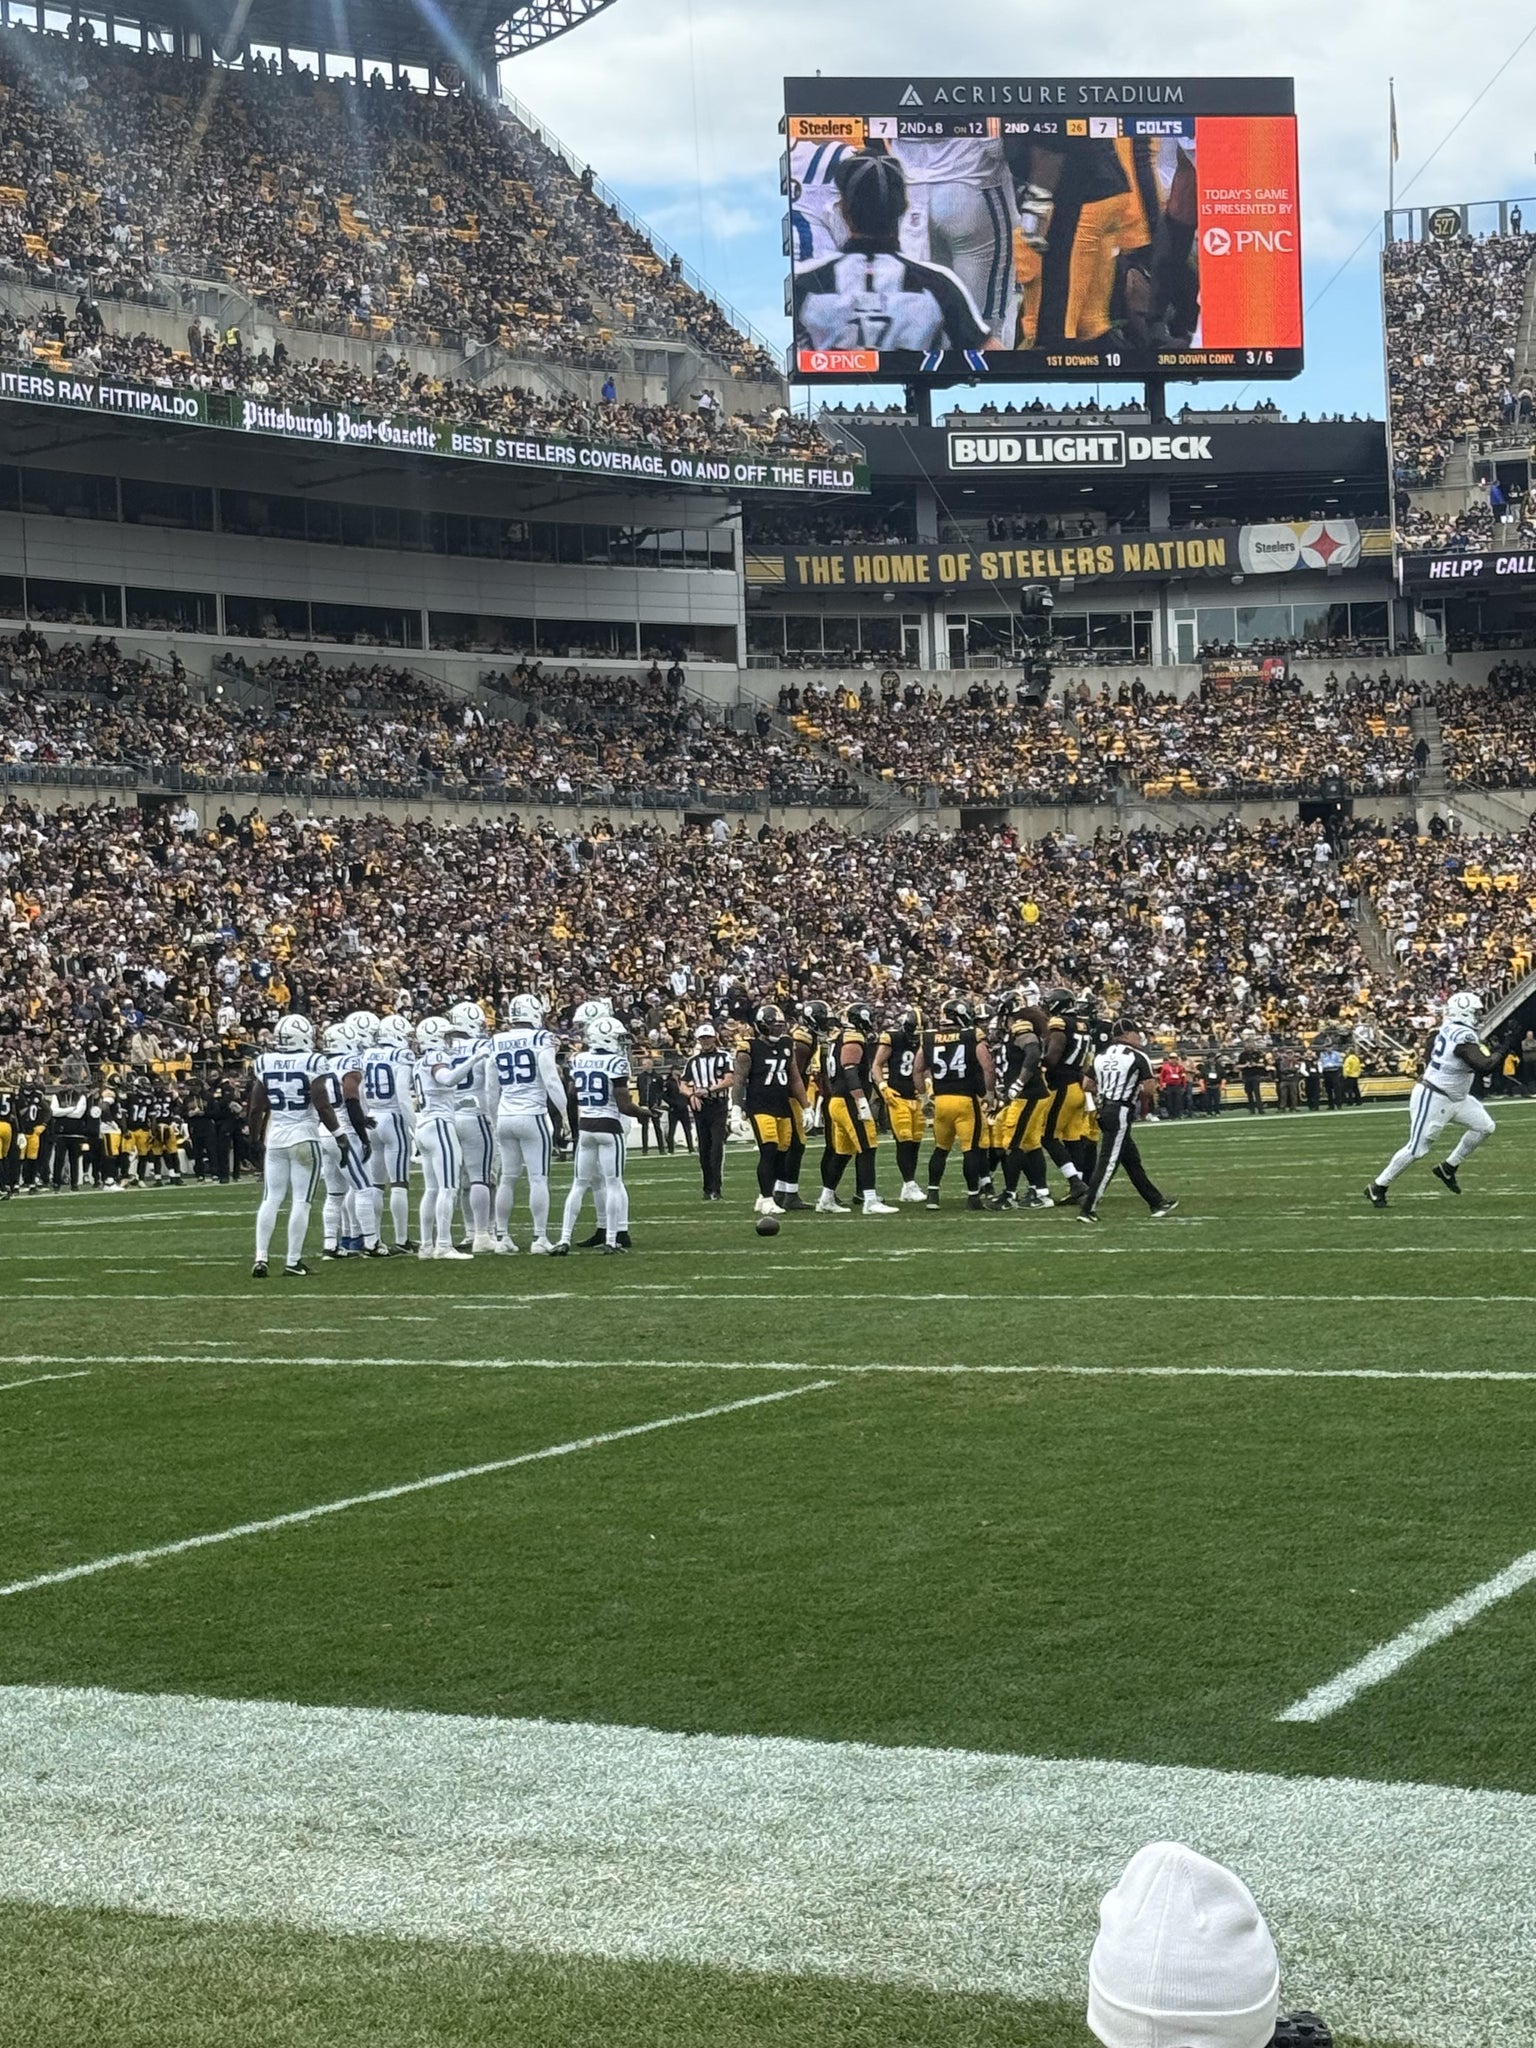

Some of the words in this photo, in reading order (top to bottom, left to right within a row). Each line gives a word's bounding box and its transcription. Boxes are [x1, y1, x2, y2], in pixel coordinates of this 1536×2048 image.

[934, 86, 1066, 104] ACRISURE
[1079, 86, 1184, 104] STADIUM
[799, 120, 852, 135] Steelers
[879, 122, 888, 134] 7
[969, 123, 983, 134] 12
[1004, 123, 1030, 134] 2ND
[1033, 123, 1058, 134] 4:52
[1071, 124, 1083, 133] 26
[1100, 123, 1108, 134] 7
[1136, 121, 1183, 134] COLTS
[1203, 189, 1252, 200] TODAY'S
[1254, 189, 1289, 199] GAME
[1202, 204, 1213, 215] IS
[1214, 204, 1276, 215] PRESENTED
[1278, 203, 1293, 214] BY
[1434, 217, 1455, 235] 527
[1233, 229, 1294, 253] PNC
[830, 356, 866, 369] PNC
[1046, 355, 1064, 367] 1ST
[1065, 355, 1099, 366] DOWNS
[1105, 354, 1120, 366] 10
[1157, 354, 1177, 365] 3RD
[1178, 354, 1208, 365] DOWN
[1208, 353, 1236, 365] CONV.
[58, 380, 94, 402] RAY
[99, 387, 198, 418] FITTIPALDO
[242, 400, 333, 440] Pittsburgh
[336, 412, 437, 449] Post-Gazette
[955, 438, 1022, 463] BUD
[1026, 438, 1118, 463] LIGHT
[1128, 436, 1212, 461] DECK
[451, 433, 491, 455] BEST
[495, 439, 577, 465] STEELERS
[579, 449, 668, 477] COVERAGE,
[670, 459, 693, 478] ON
[695, 462, 730, 480] AND
[734, 465, 768, 483] OFF
[772, 467, 805, 485] THE
[808, 469, 854, 487] FIELD
[1255, 541, 1295, 554] Steelers
[795, 555, 846, 585] THE
[853, 555, 931, 584] HOME
[937, 553, 971, 583] OF
[981, 545, 1115, 581] STEELERS
[1122, 538, 1226, 572] NATION
[1429, 559, 1483, 579] HELP?
[1495, 556, 1536, 575] CALL
[1240, 664, 1259, 672] OUR
[273, 1060, 297, 1070] PRATT
[495, 1048, 536, 1085] 99
[933, 1044, 967, 1080] 54
[1102, 1060, 1119, 1071] 22
[764, 1059, 788, 1086] 76
[365, 1063, 395, 1099] 40
[573, 1071, 609, 1106] 29
[263, 1071, 312, 1111] 53
[132, 1104, 147, 1122] 14
